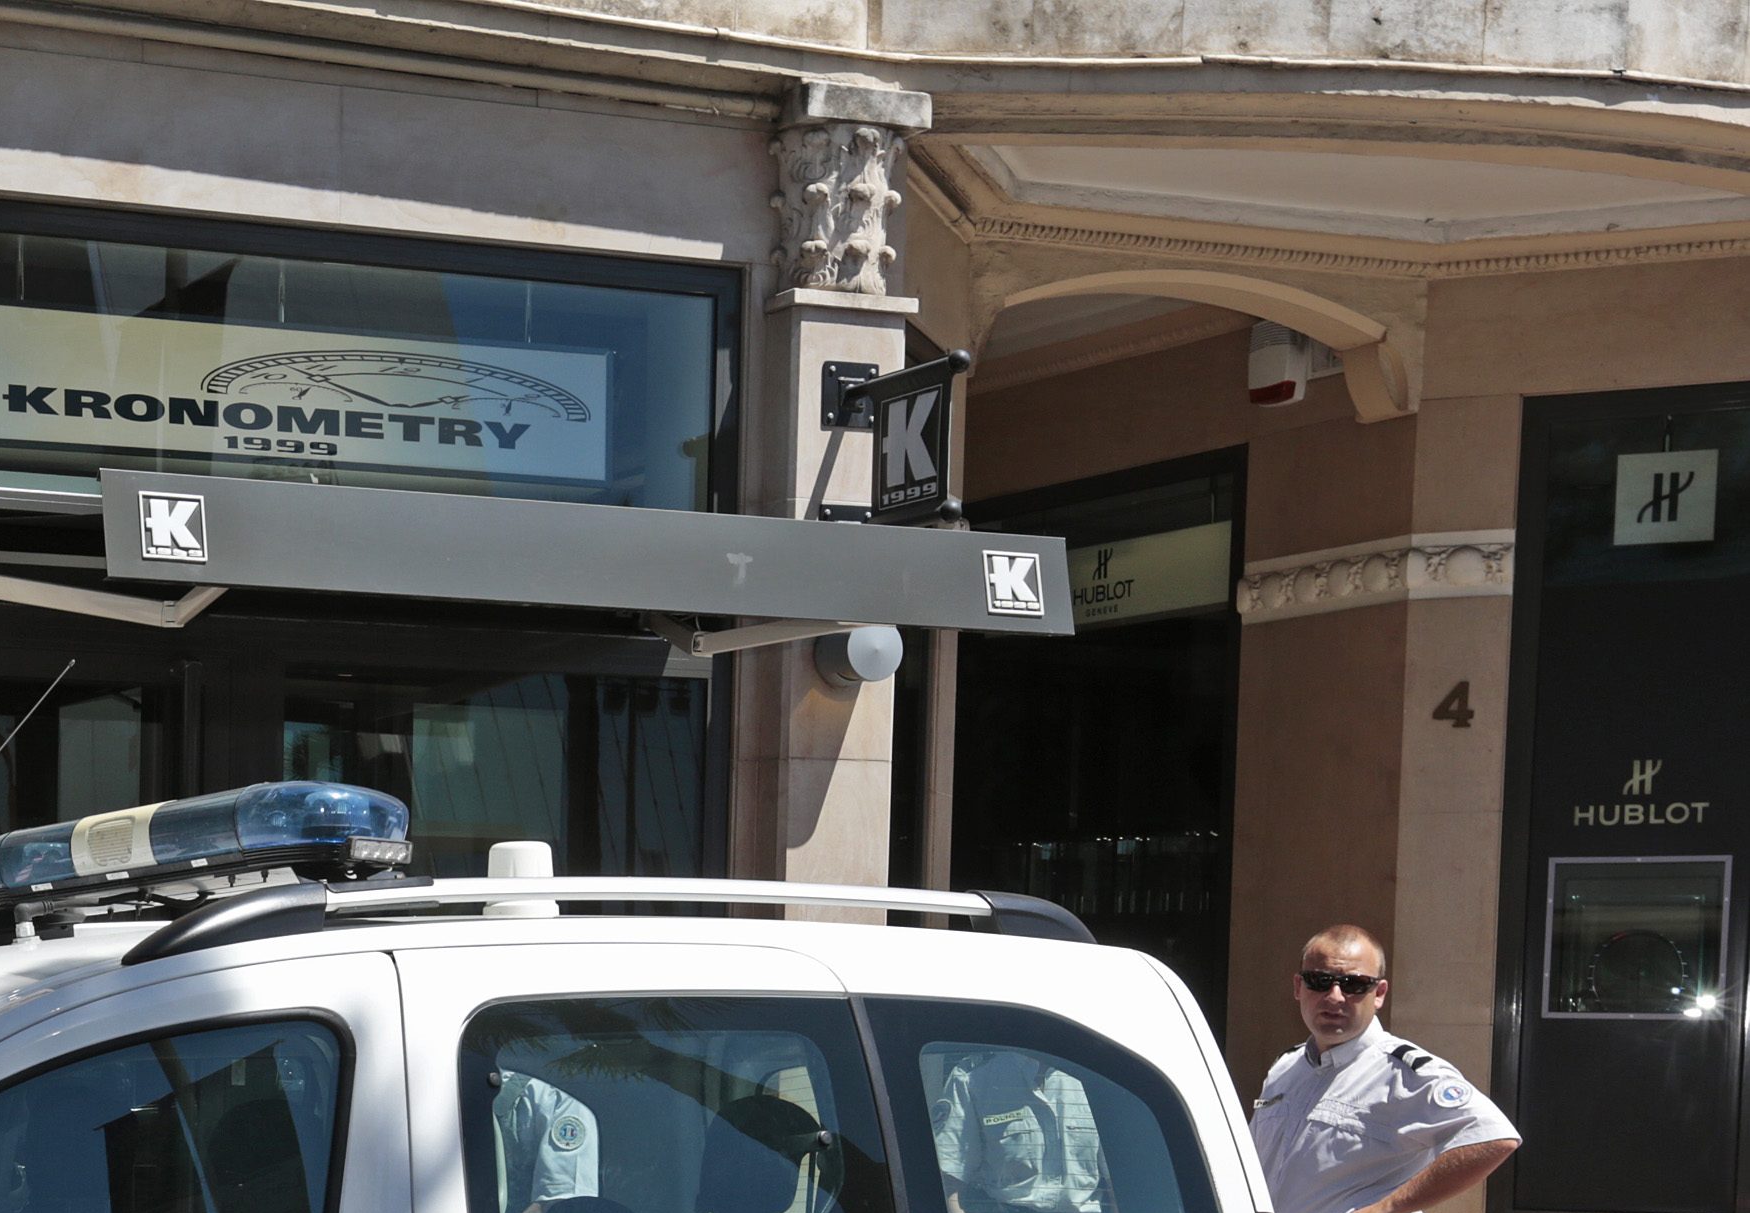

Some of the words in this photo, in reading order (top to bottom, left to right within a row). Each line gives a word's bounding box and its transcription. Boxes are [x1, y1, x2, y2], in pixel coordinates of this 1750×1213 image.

[2, 384, 531, 450] KRONOMETRY
[223, 435, 338, 456] 1999
[883, 390, 939, 488] K
[882, 482, 937, 505] 1999
[146, 498, 201, 549] K
[990, 555, 1038, 602] K
[1073, 579, 1135, 605] HUBLOT
[1432, 681, 1475, 728] 4
[1573, 802, 1710, 826] HUBLOT
[985, 1111, 1022, 1124] POLICE
